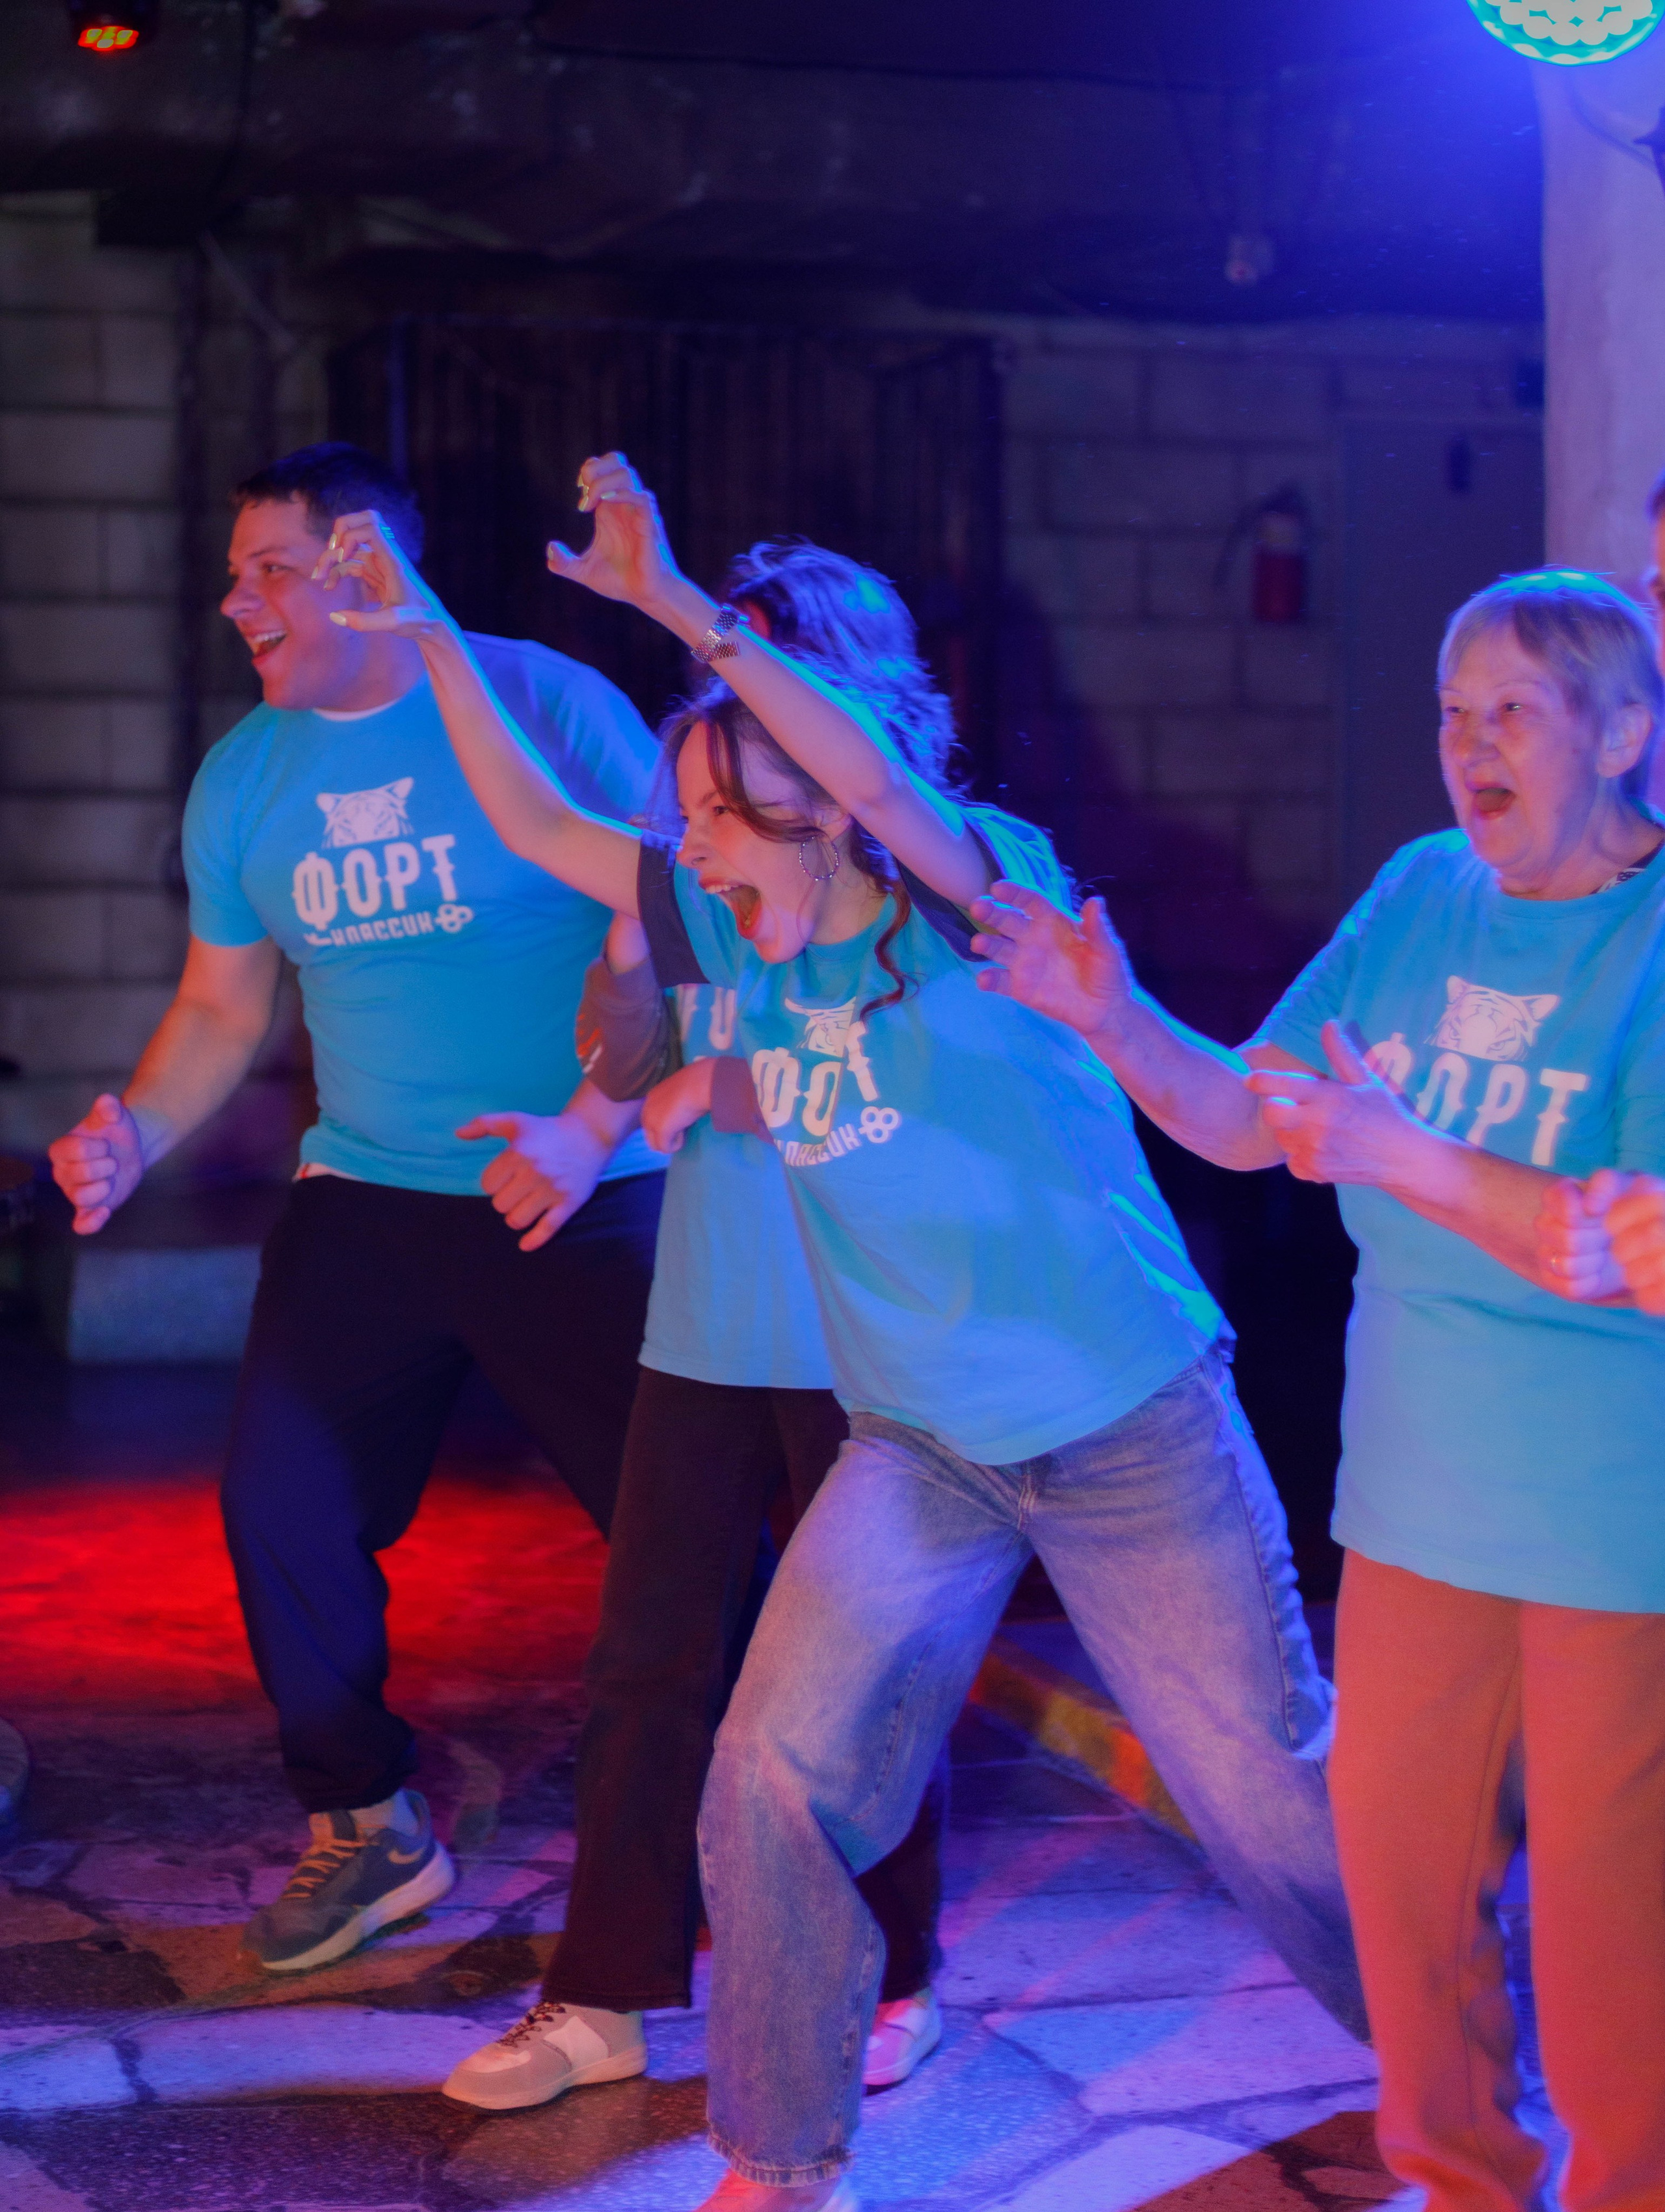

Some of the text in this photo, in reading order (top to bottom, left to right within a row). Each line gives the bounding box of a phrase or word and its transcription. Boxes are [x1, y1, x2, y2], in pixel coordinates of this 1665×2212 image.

[293, 834, 457, 931] ФОРТ
[330, 911, 435, 946] КЛАССИК
[752, 1021, 879, 1136] ФОТ
